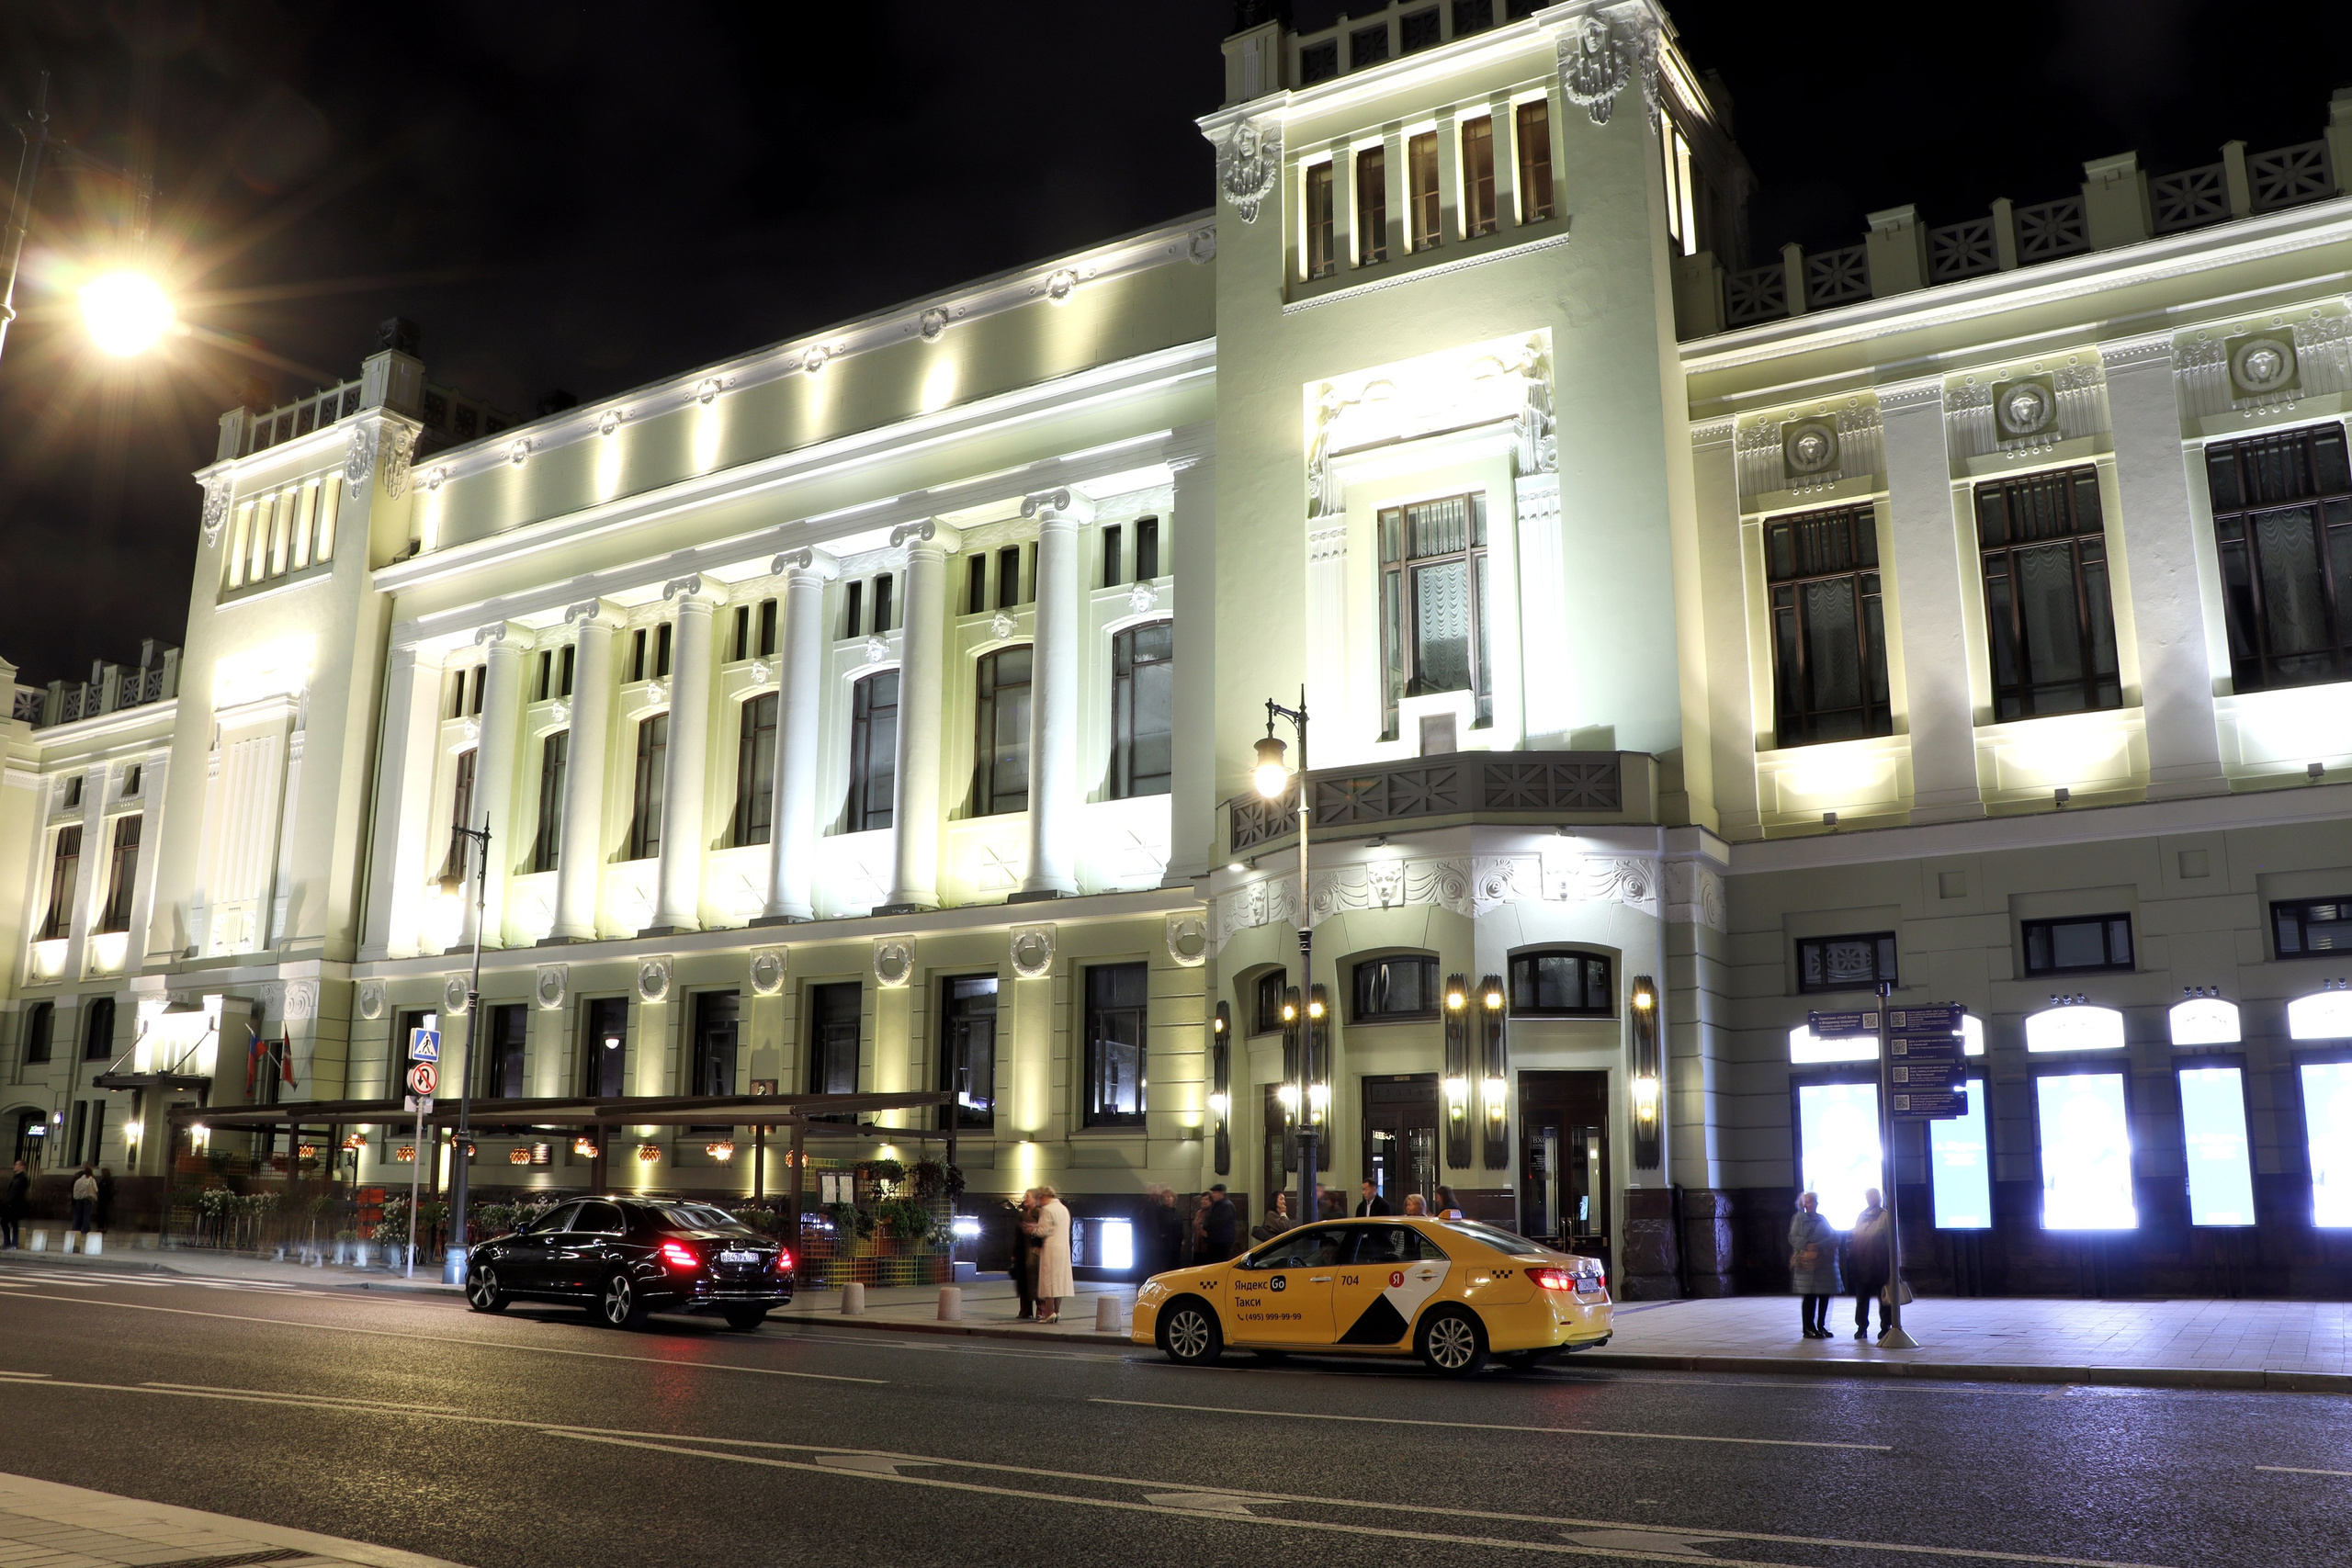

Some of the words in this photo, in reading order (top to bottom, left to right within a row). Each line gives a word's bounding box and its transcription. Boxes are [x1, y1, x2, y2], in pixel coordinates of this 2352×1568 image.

[1235, 1280, 1268, 1292] Яндекс
[1272, 1278, 1284, 1289] Go
[1341, 1275, 1359, 1286] 704
[1235, 1296, 1261, 1307] Такси
[1245, 1313, 1264, 1321] (495)
[1265, 1313, 1302, 1321] 999-99-99
